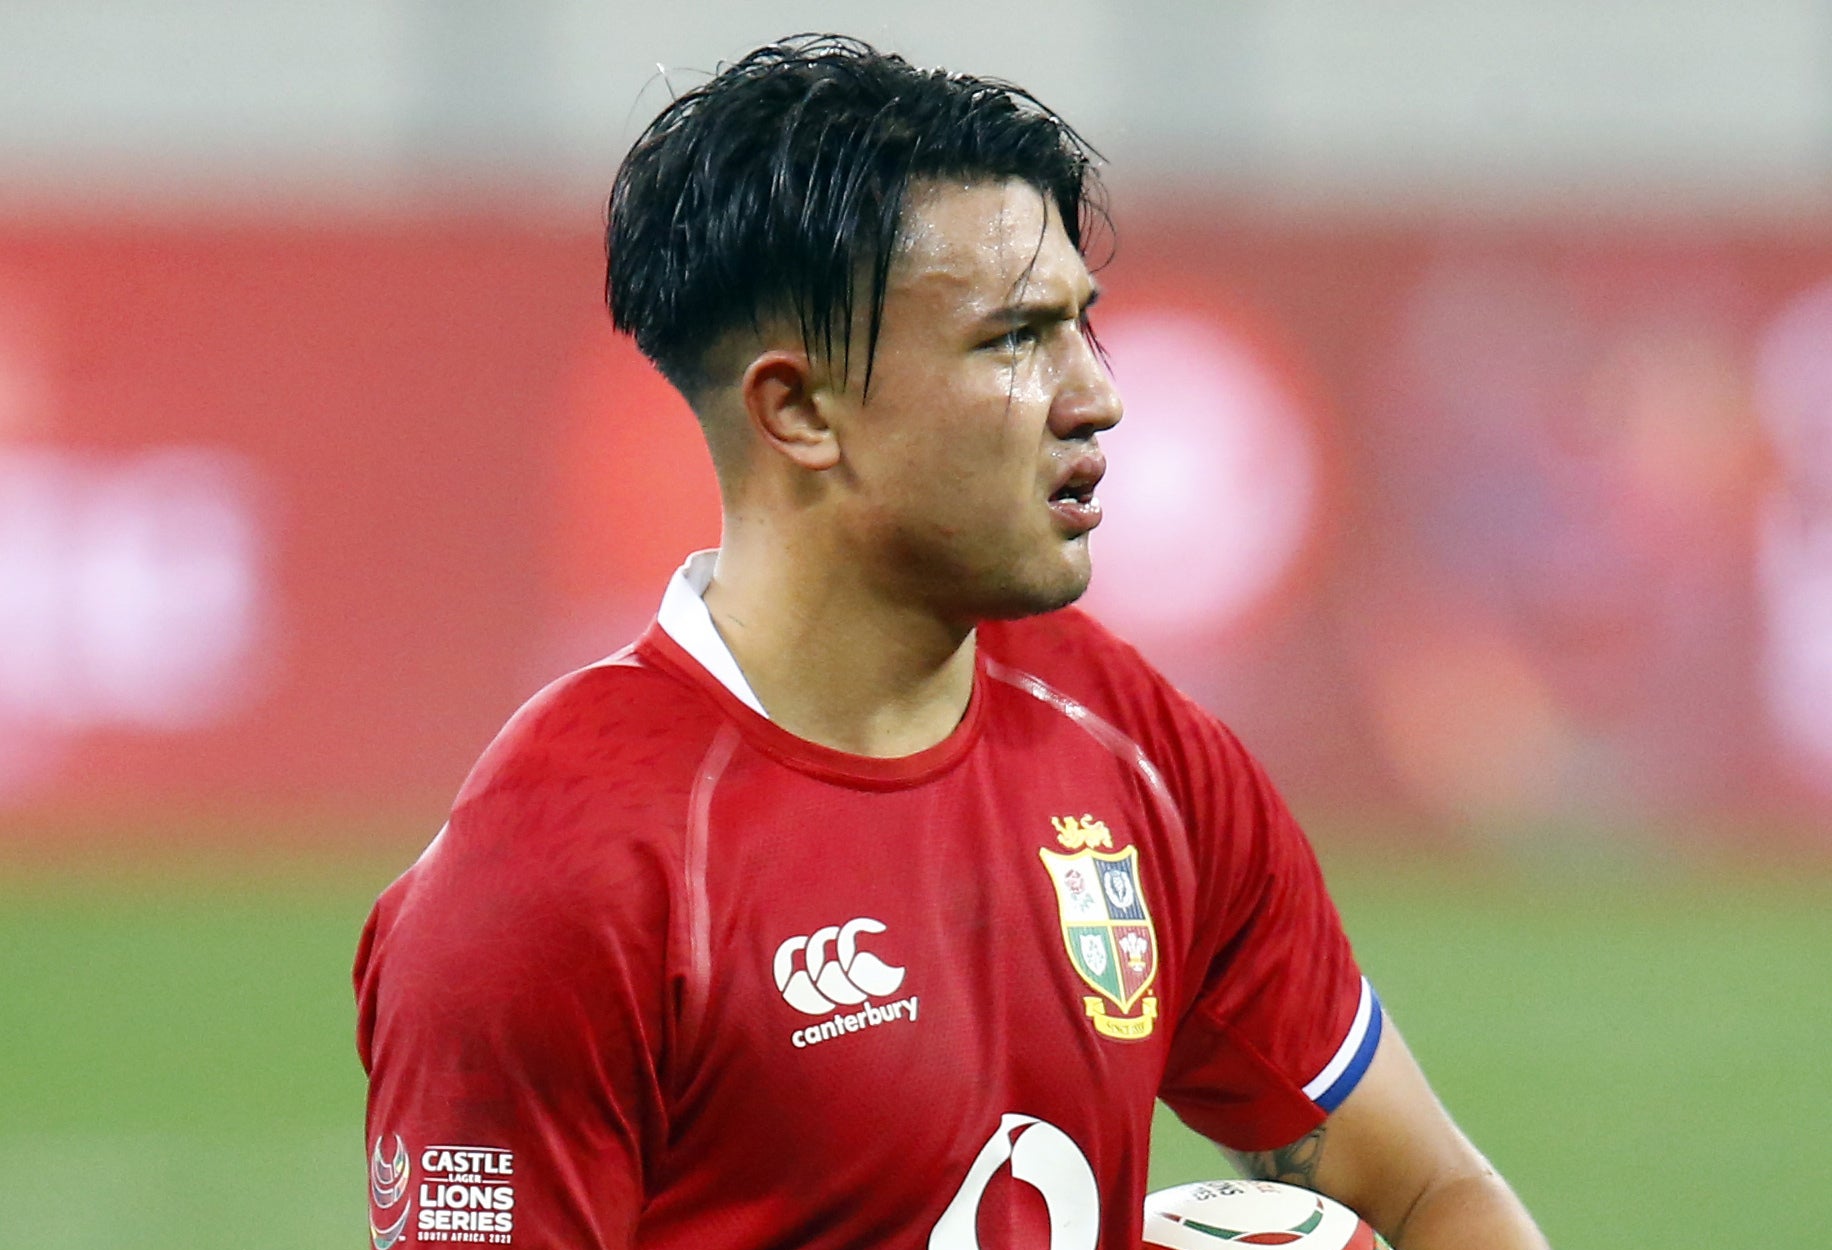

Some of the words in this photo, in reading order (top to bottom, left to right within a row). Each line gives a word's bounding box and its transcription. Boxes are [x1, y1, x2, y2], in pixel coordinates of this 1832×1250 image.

[792, 996, 917, 1048] canterbury
[422, 1150, 514, 1174] CASTLE
[449, 1174, 482, 1183] LAGER
[419, 1184, 514, 1210] LIONS
[418, 1210, 513, 1232] SERIES
[417, 1231, 448, 1241] SOUTH
[451, 1232, 486, 1243] AFRICA
[489, 1233, 512, 1244] 2021
